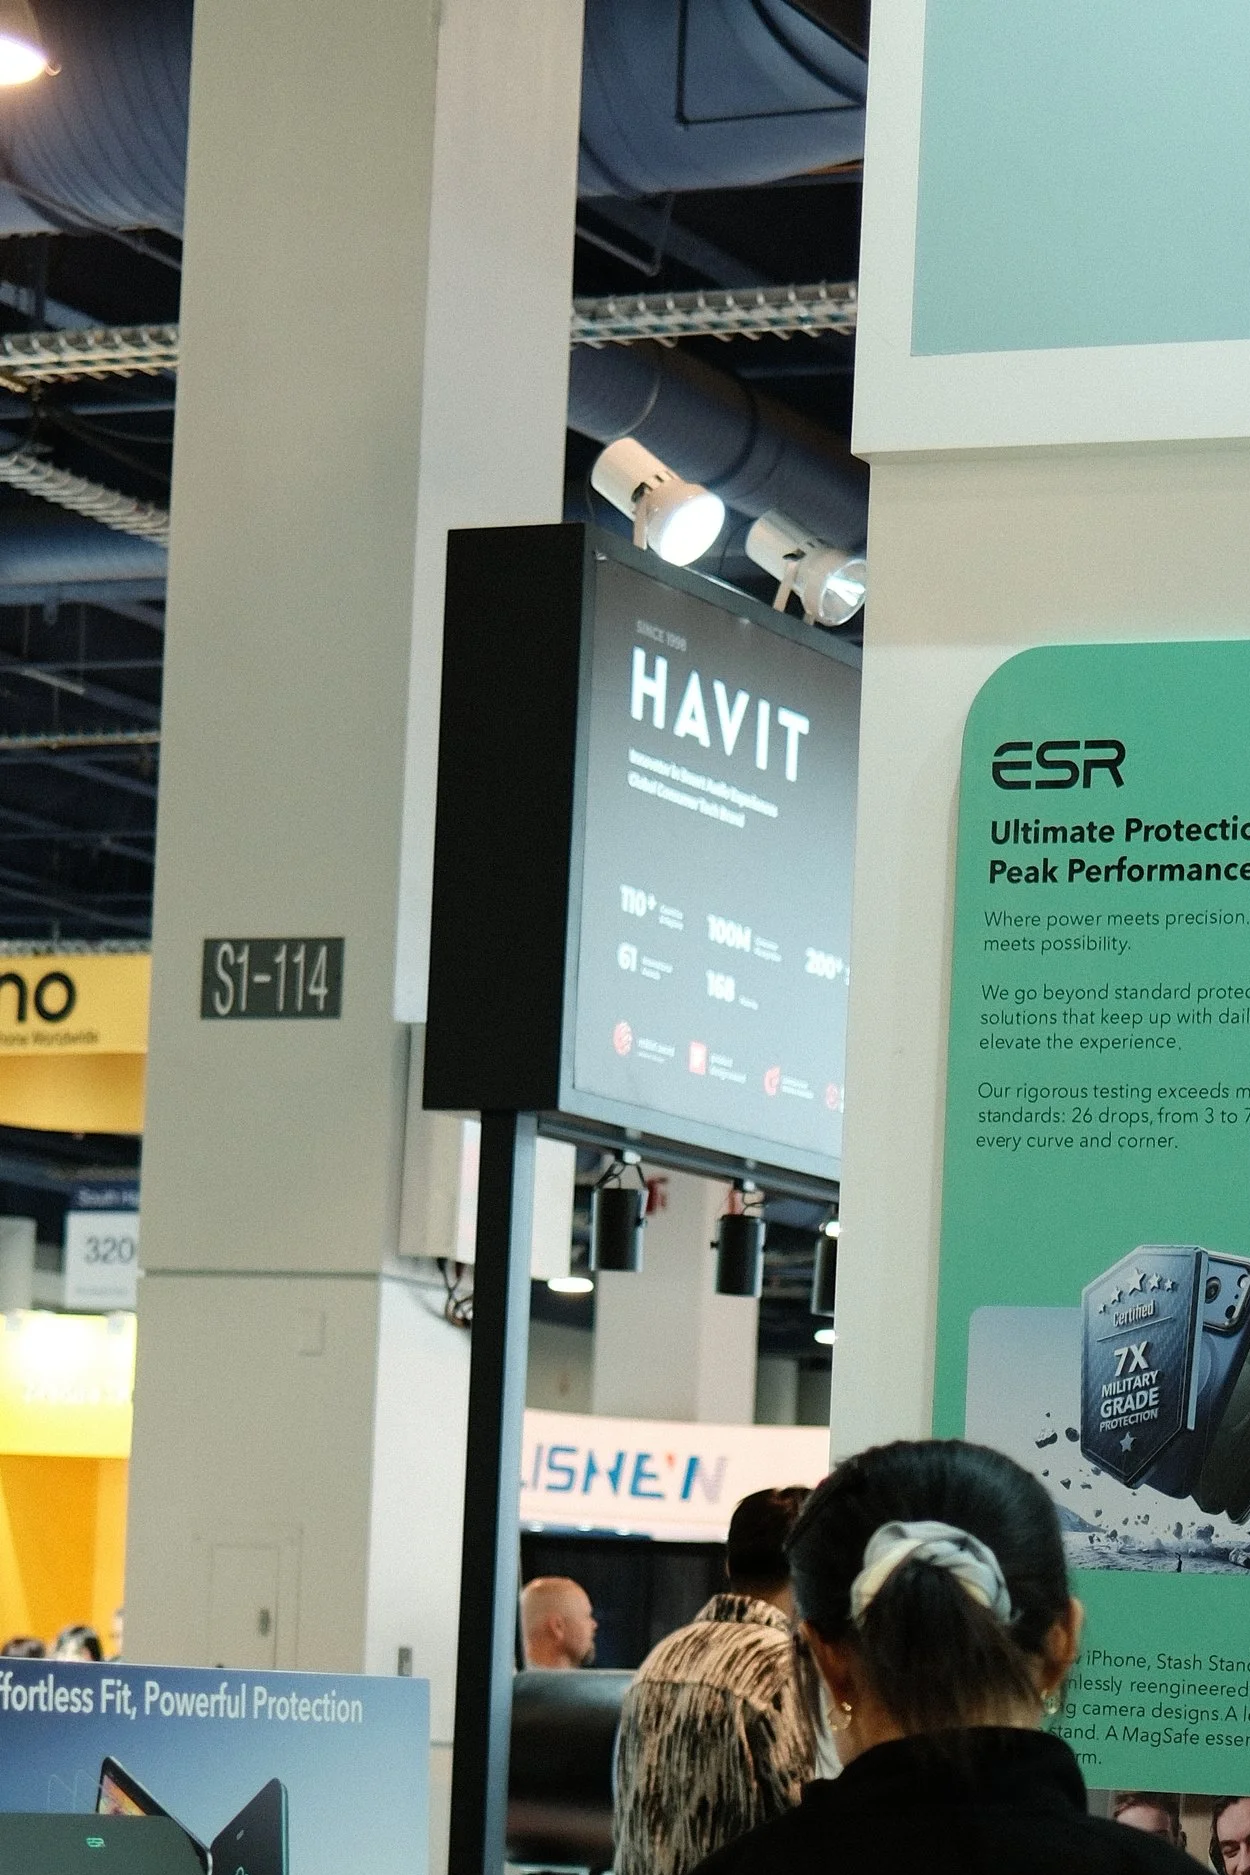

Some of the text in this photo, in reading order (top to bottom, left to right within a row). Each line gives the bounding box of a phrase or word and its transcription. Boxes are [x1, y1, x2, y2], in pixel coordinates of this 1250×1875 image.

[630, 646, 809, 782] HAVIT
[992, 740, 1125, 790] ESR
[992, 819, 1114, 844] Ultimate
[990, 858, 1058, 884] Peak
[985, 911, 1040, 927] Where
[1047, 915, 1102, 931] power
[1108, 912, 1159, 925] meets
[1166, 909, 1249, 930] precision.
[984, 935, 1130, 955] meets possibility.
[212, 943, 328, 1015] S1-114
[982, 985, 1008, 1000] We
[1015, 989, 1037, 1004] go
[1044, 983, 1108, 1004] beyond
[1115, 983, 1190, 999] standard
[981, 1010, 1057, 1025] solutions
[1063, 1008, 1095, 1024] that
[1101, 1008, 1143, 1028] keep
[1150, 1009, 1171, 1028] up
[1177, 1008, 1211, 1024] with
[980, 1033, 1040, 1049] elevate
[1047, 1033, 1073, 1049] the
[978, 1082, 1010, 1098] Our
[1017, 1083, 1088, 1103] rigorous
[1093, 1084, 1151, 1103] testing
[1158, 1082, 1229, 1099] exceeds
[979, 1106, 1065, 1123] standards:
[1072, 1107, 1092, 1123] 26
[1099, 1107, 1152, 1127] drops,
[1157, 1107, 1198, 1123] from
[1205, 1107, 1214, 1124] 3
[1220, 1110, 1237, 1123] to
[976, 1132, 1177, 1151] every curve and corner.
[1114, 1300, 1155, 1328] Certified
[1114, 1341, 1149, 1377] 7X
[1102, 1370, 1158, 1397] MILITARY
[1101, 1387, 1159, 1418] GRADE
[1100, 1409, 1158, 1432] PROTECTION
[1087, 1650, 1150, 1671] iPhone,
[1157, 1653, 1201, 1670] Stash
[1131, 1679, 1248, 1698] reengineered
[102, 1678, 137, 1720] Fit,
[145, 1681, 246, 1718] Powerful
[254, 1686, 363, 1723] Protection
[1083, 1704, 1145, 1717] camera
[1105, 1725, 1118, 1740] A
[1123, 1726, 1199, 1747] MagSafe
